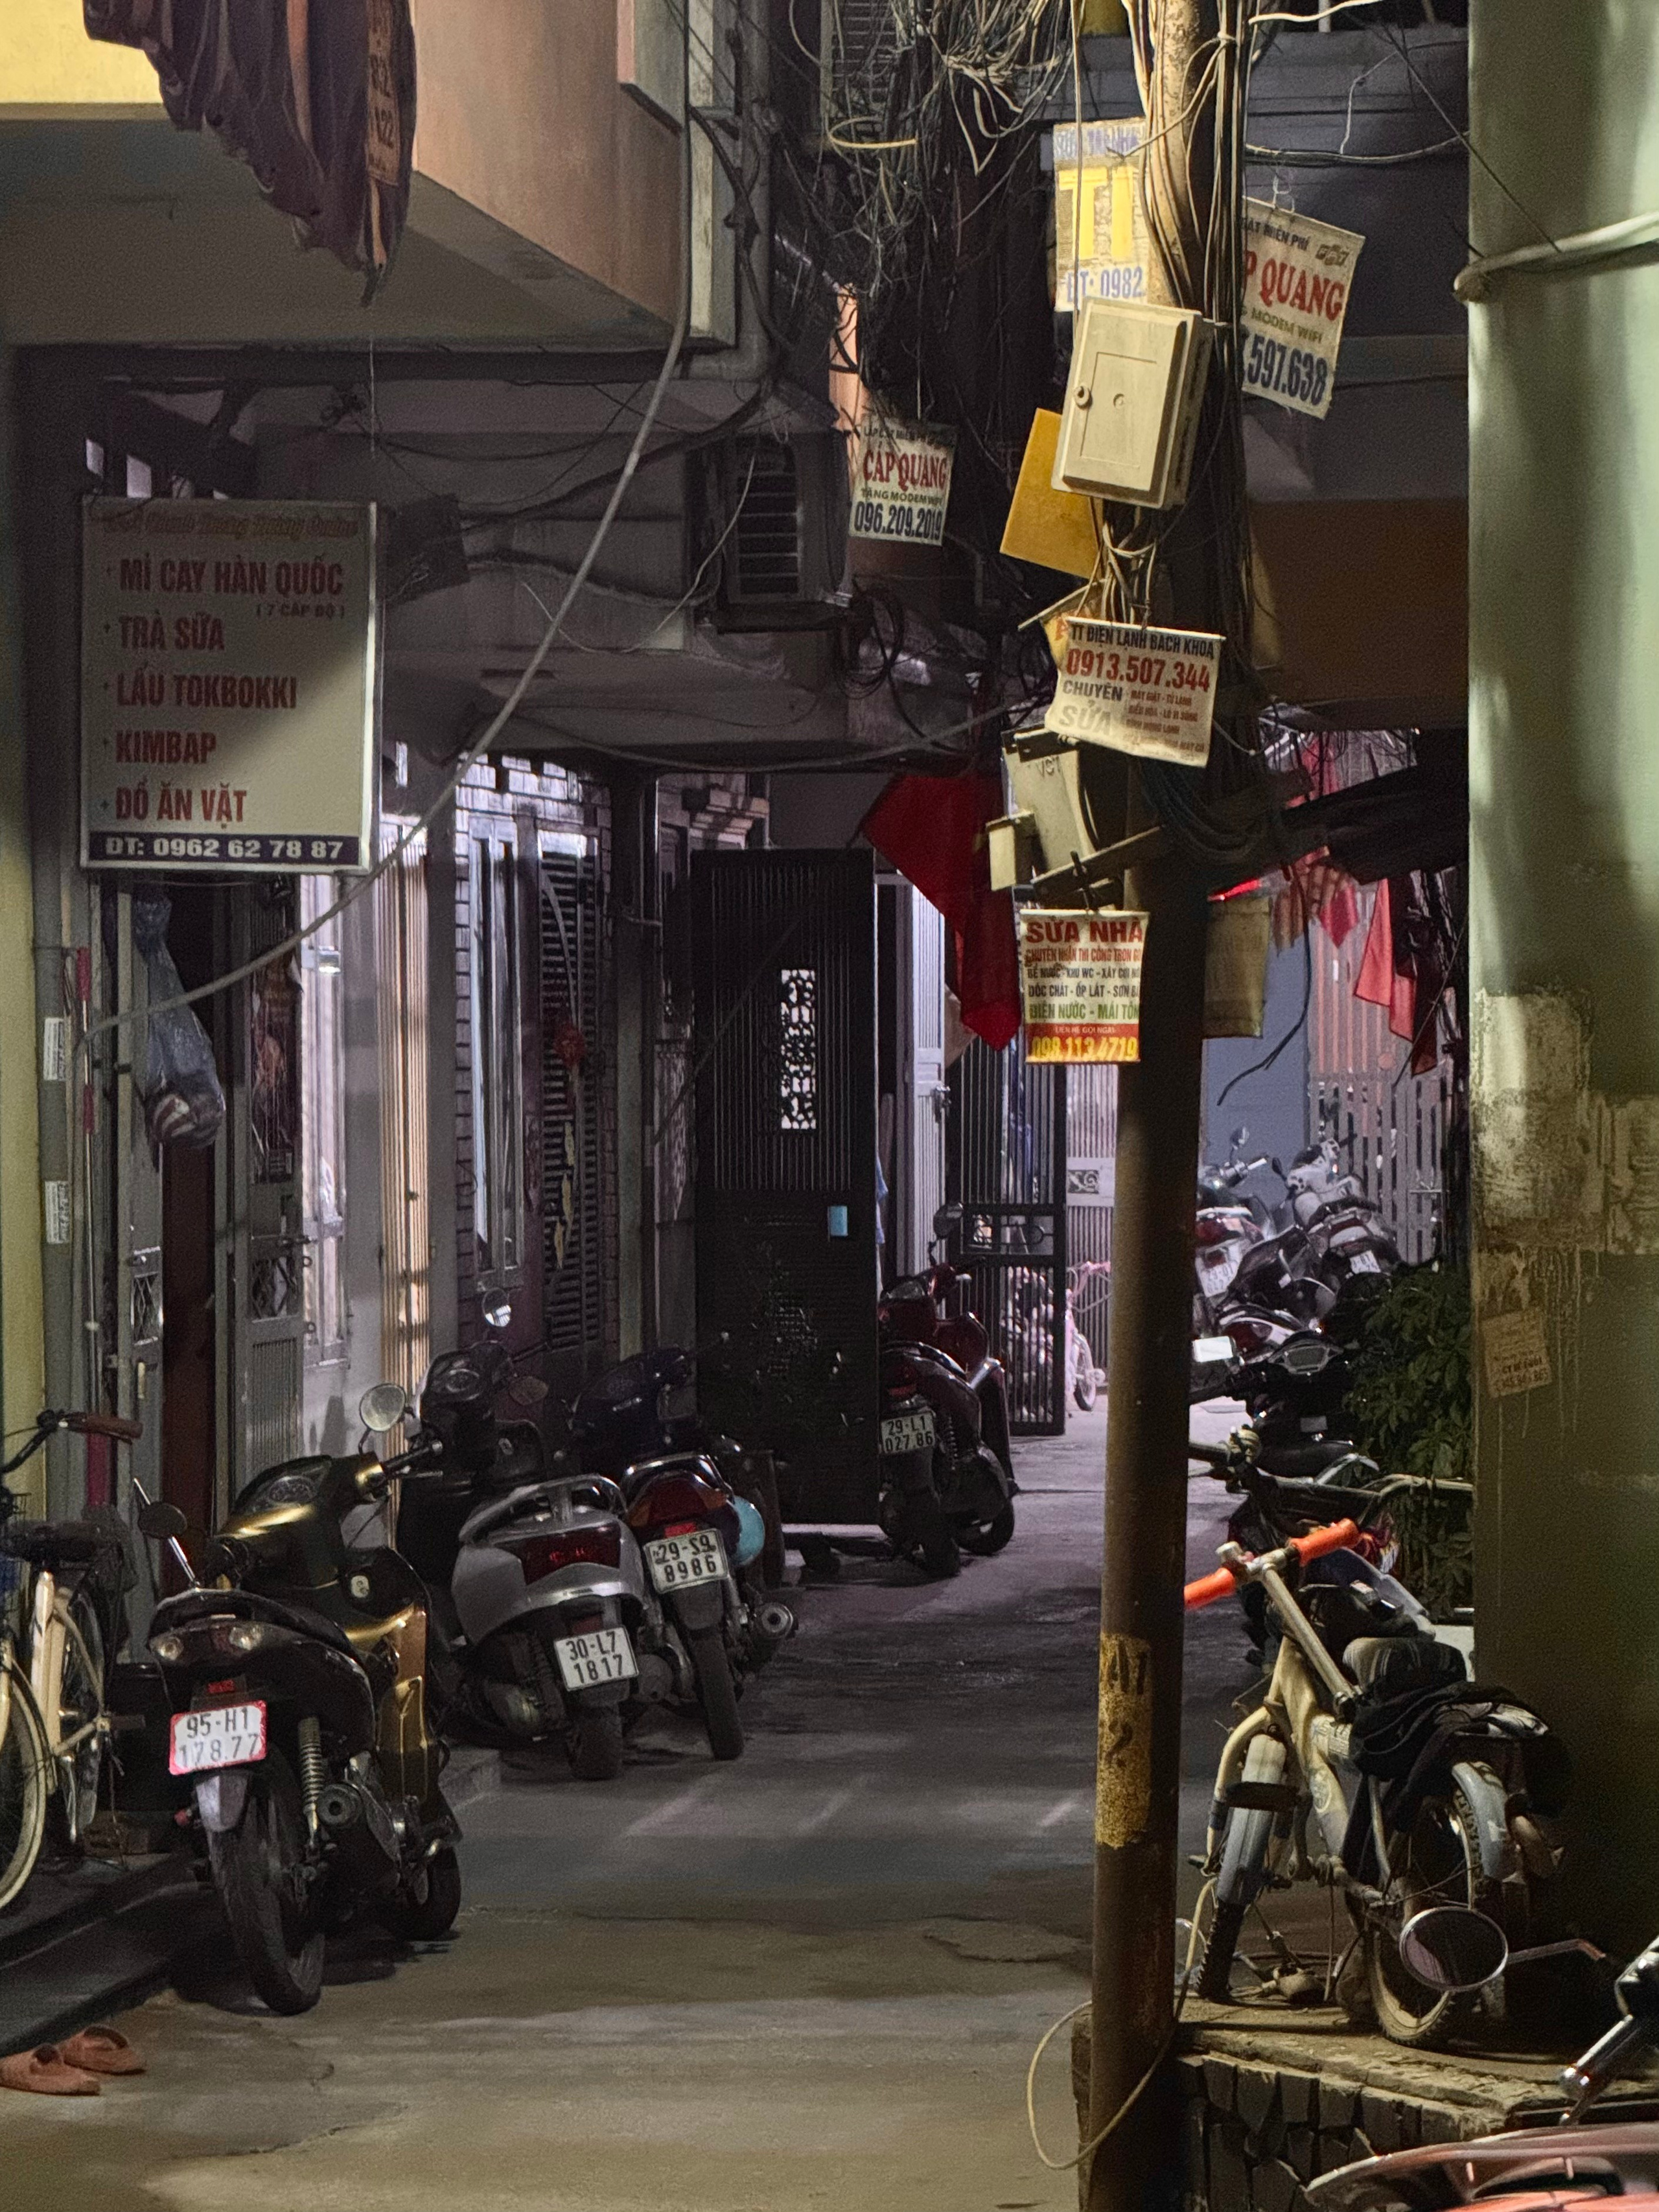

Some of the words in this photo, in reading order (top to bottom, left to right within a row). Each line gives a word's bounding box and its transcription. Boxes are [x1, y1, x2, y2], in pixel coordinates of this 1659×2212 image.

[1260, 258, 1345, 321] QUANG
[1297, 325, 1323, 343] WIFI
[898, 452, 947, 492] QUANG
[890, 491, 927, 504] MODEM
[159, 557, 207, 594] CAY
[215, 554, 267, 595] HÀN
[274, 554, 344, 598] QUỐC
[118, 608, 166, 651] TRÀ
[1066, 648, 1211, 693] 0913.507.344
[174, 673, 297, 709] TOKBOKKI
[1062, 681, 1123, 702] CHUYÊN
[1059, 699, 1111, 736] SỬA
[115, 728, 217, 764] KIMBAP
[157, 780, 192, 821] ĂN
[201, 781, 247, 829] VẶT
[153, 837, 219, 858] 0962
[227, 839, 261, 859] 62
[270, 840, 303, 859] 78
[310, 841, 343, 859] 87
[1025, 915, 1080, 944] SỬA
[1082, 968, 1094, 979] WC
[664, 1554, 717, 1583] 8986
[574, 1653, 623, 1684] 1817
[186, 1706, 249, 1739] 95-H1
